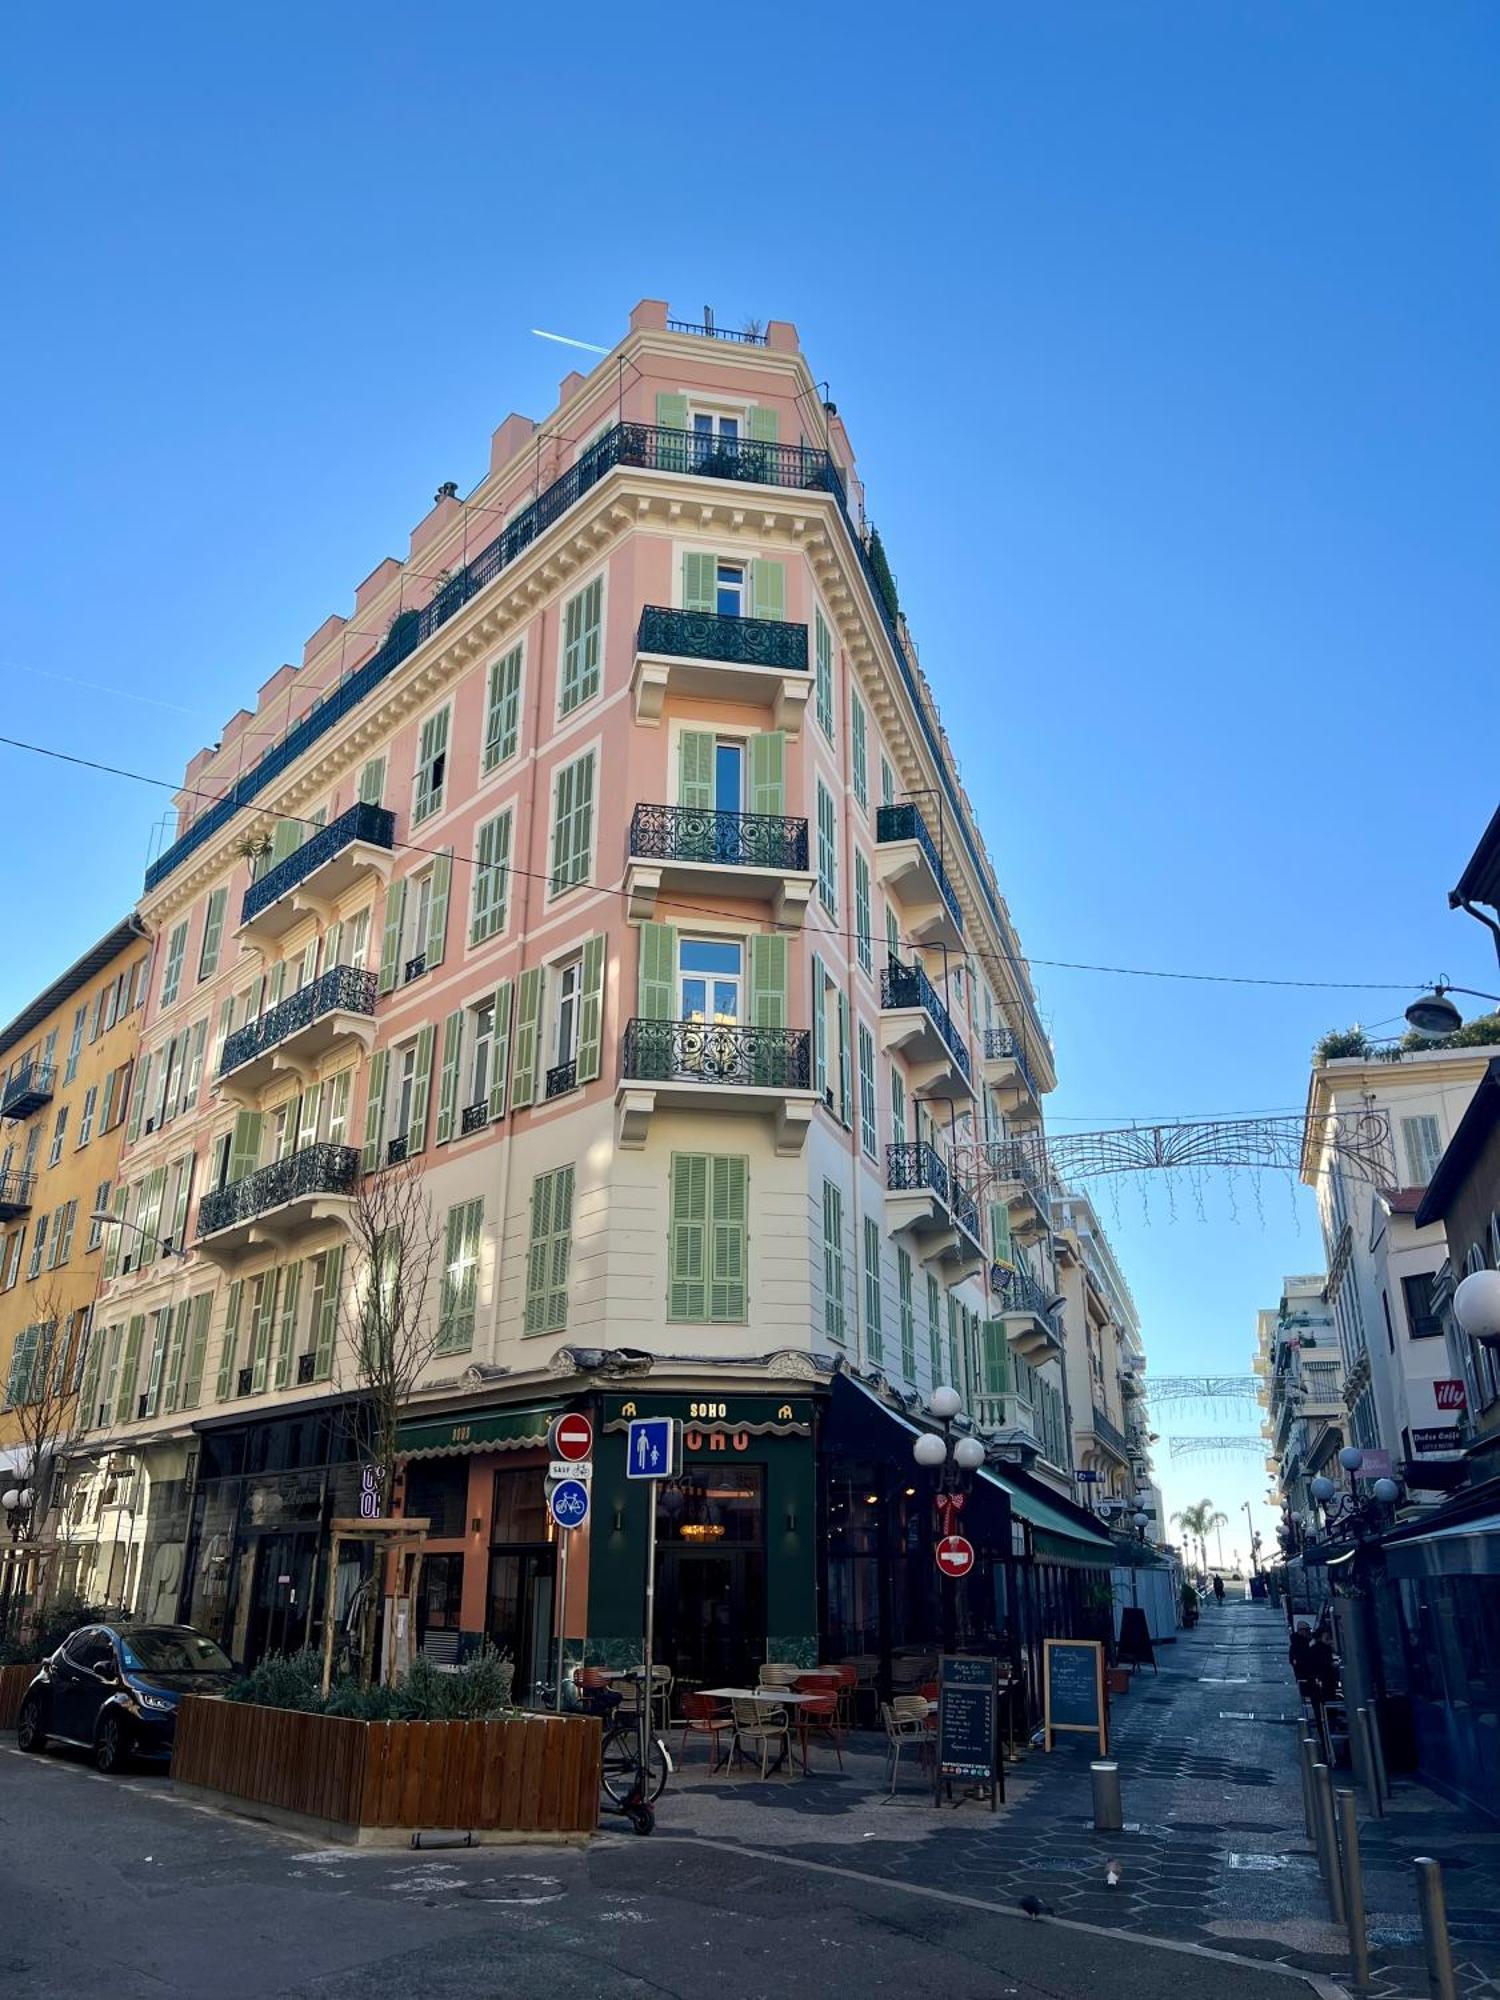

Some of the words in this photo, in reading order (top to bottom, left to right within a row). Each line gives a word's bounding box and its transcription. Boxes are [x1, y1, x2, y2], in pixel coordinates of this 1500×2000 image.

[1438, 1384, 1464, 1408] illy
[690, 1403, 727, 1418] SOHO
[686, 1429, 749, 1451] OHO
